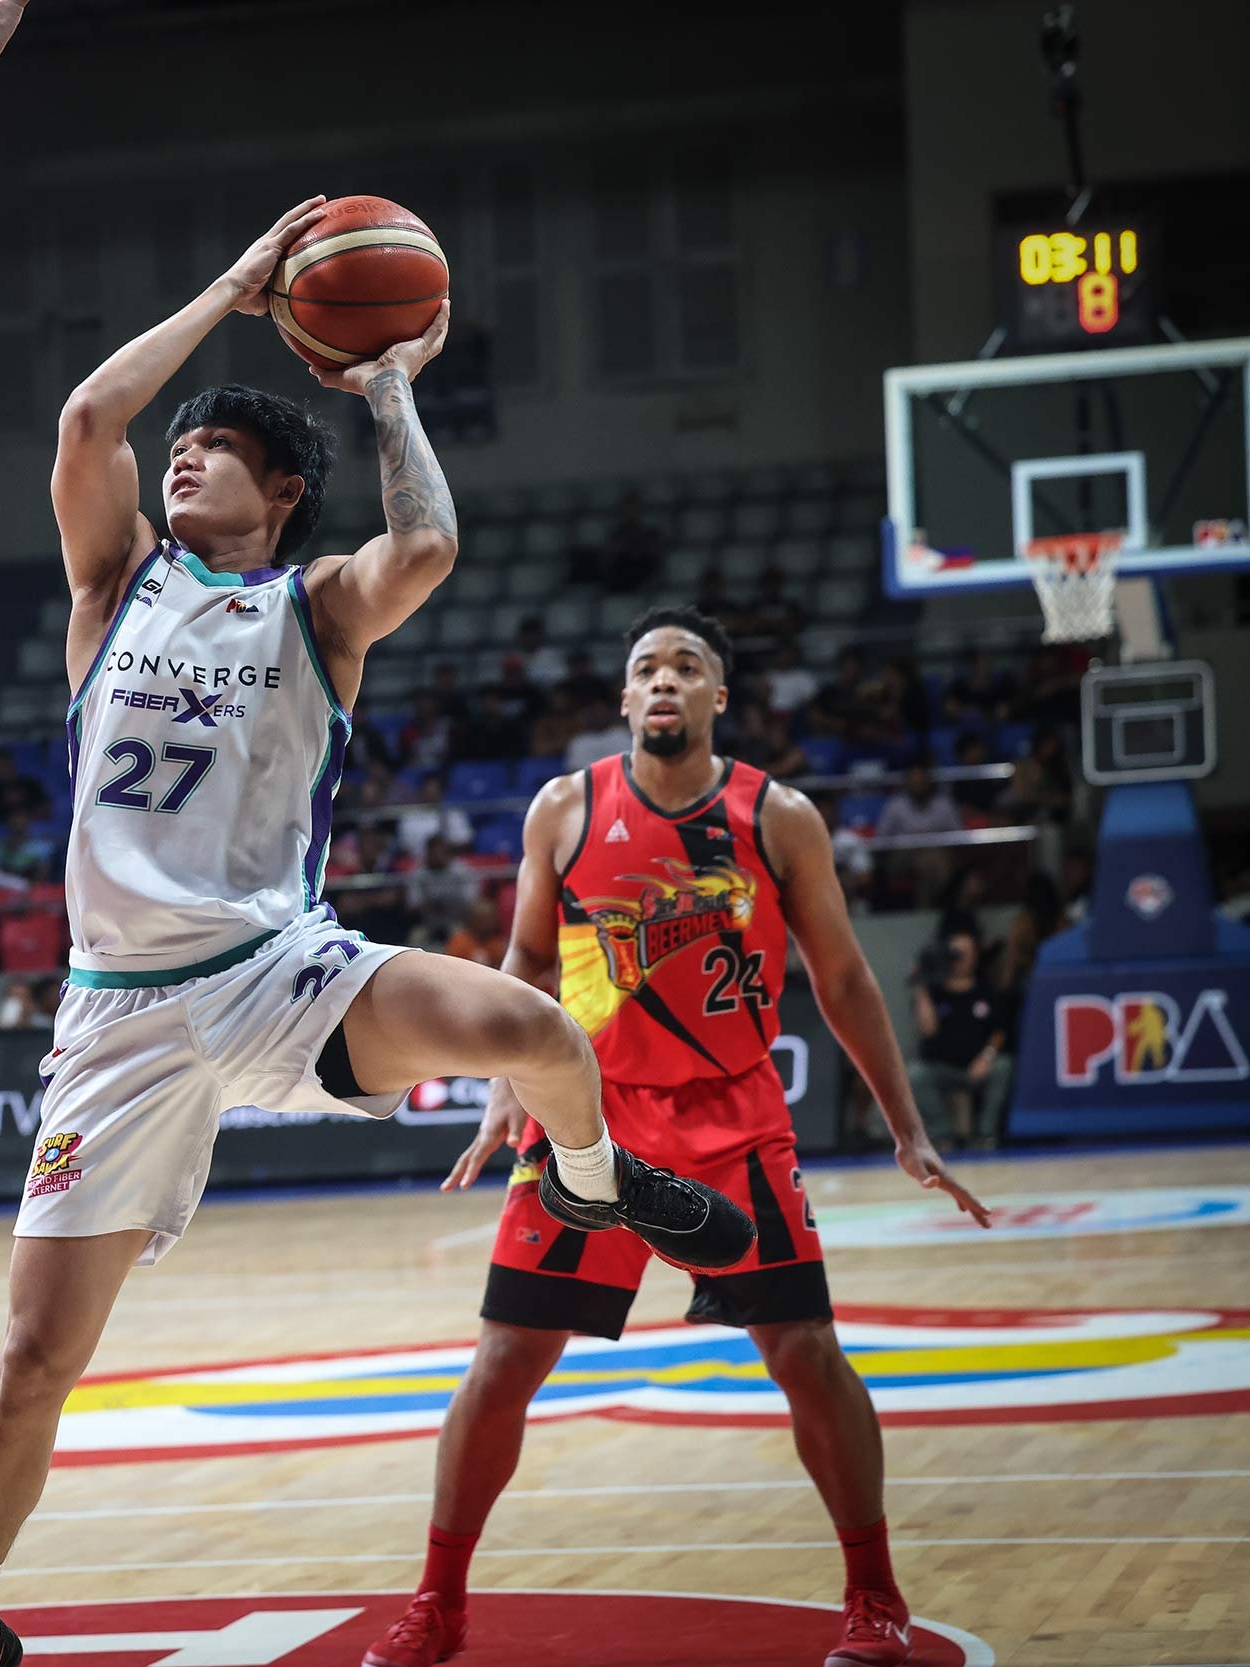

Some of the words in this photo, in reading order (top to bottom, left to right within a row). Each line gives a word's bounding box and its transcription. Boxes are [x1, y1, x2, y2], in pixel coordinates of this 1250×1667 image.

[1078, 271, 1119, 334] 8
[95, 737, 217, 814] 27
[702, 945, 772, 1017] 24
[1055, 988, 1249, 1088] PBA
[39, 1132, 79, 1157] SURF
[53, 1171, 80, 1183] FIBER
